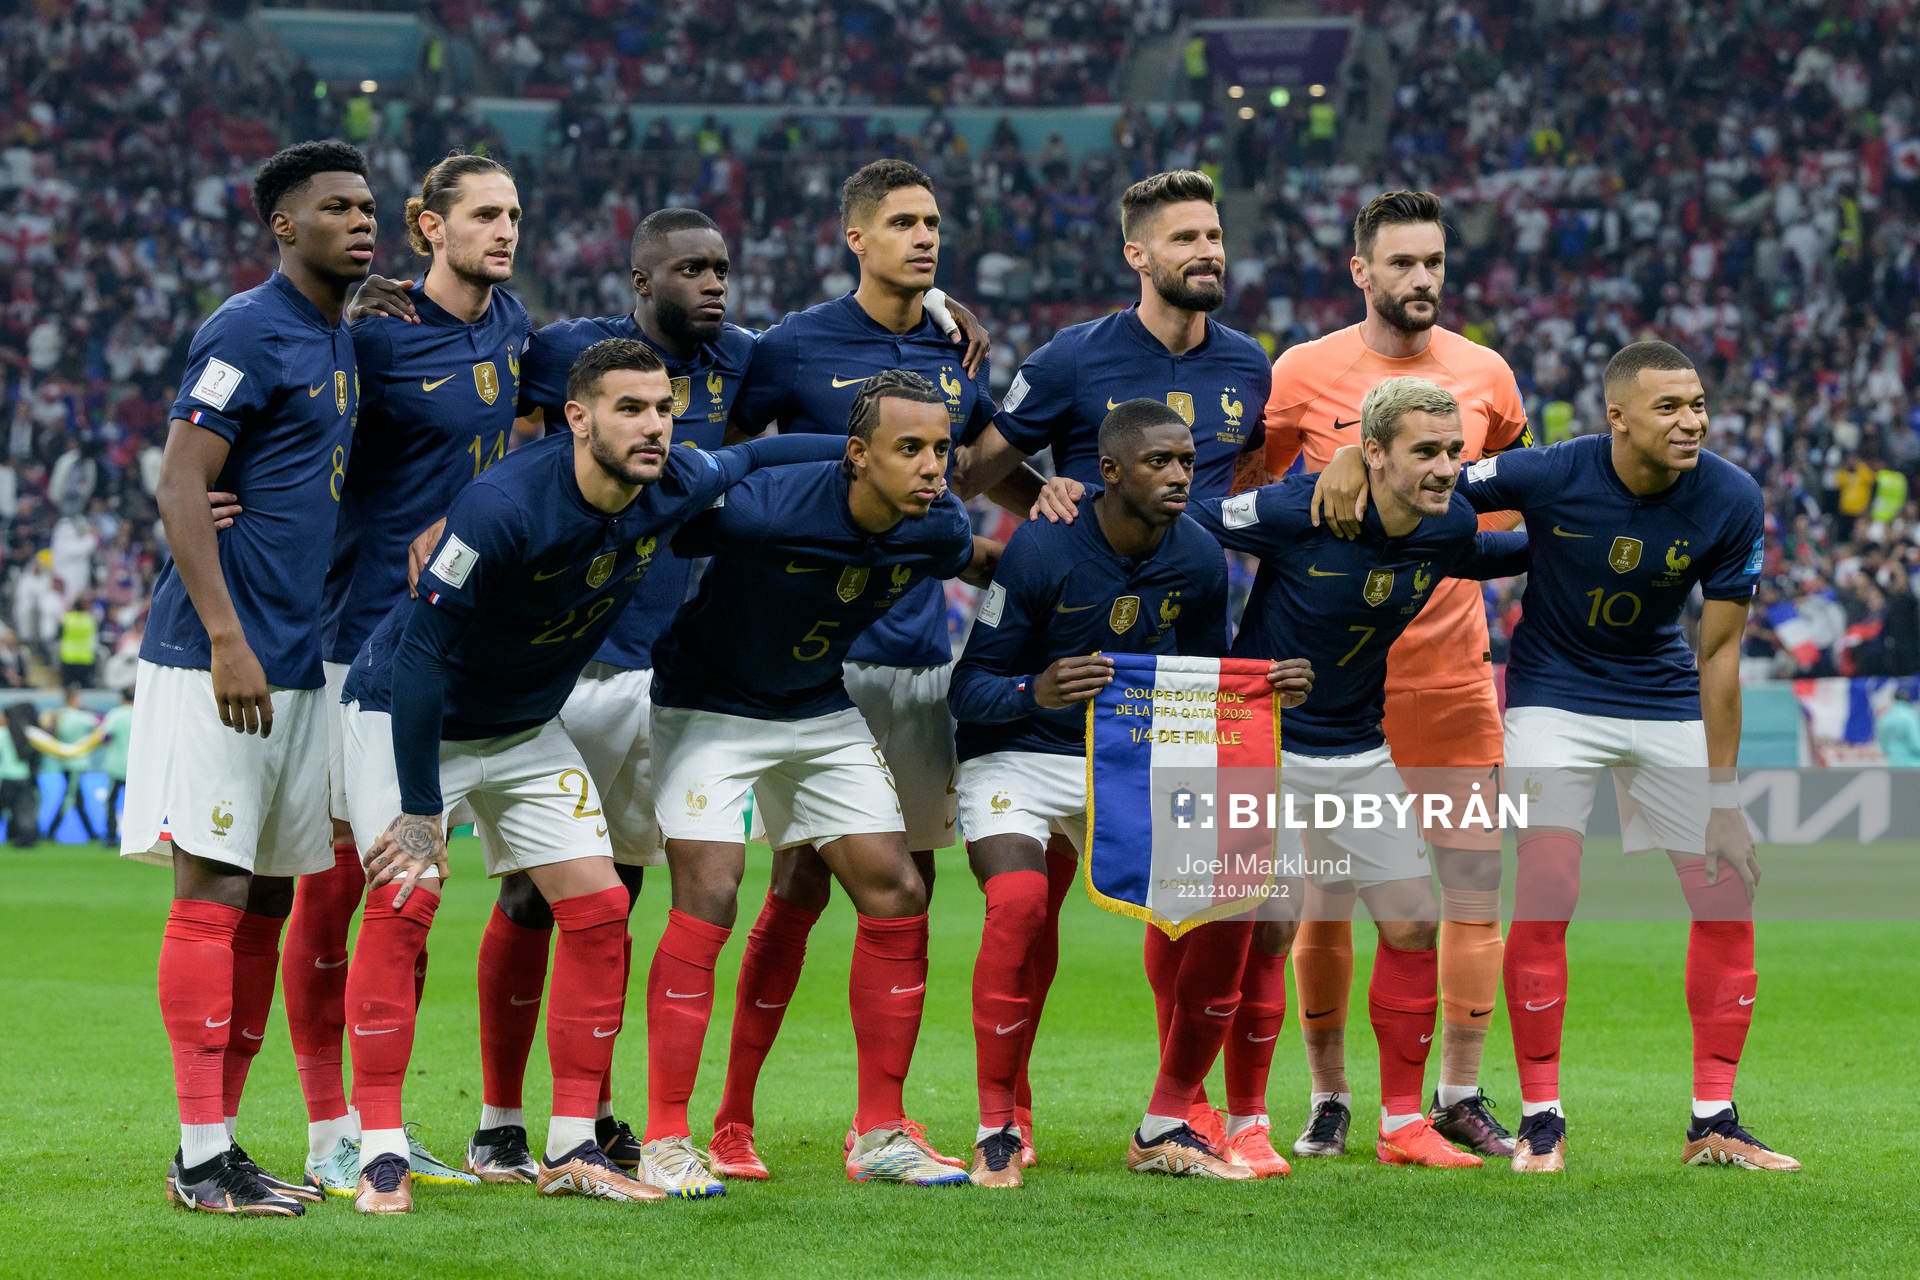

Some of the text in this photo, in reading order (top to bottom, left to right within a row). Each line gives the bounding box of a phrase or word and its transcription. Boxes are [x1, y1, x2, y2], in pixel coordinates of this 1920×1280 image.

[329, 445, 345, 502] 8
[467, 430, 504, 479] 14
[530, 597, 615, 645] 22
[1585, 587, 1642, 627] 10
[792, 620, 841, 661] 5
[1336, 625, 1377, 667] 7
[1115, 704, 1133, 716] DE
[1134, 705, 1151, 718] LA
[1223, 708, 1253, 720] 2022
[1124, 687, 1246, 704] COUPE DU MONDE
[1129, 727, 1242, 745] 1/4 DE FINALE
[558, 769, 602, 819] 2
